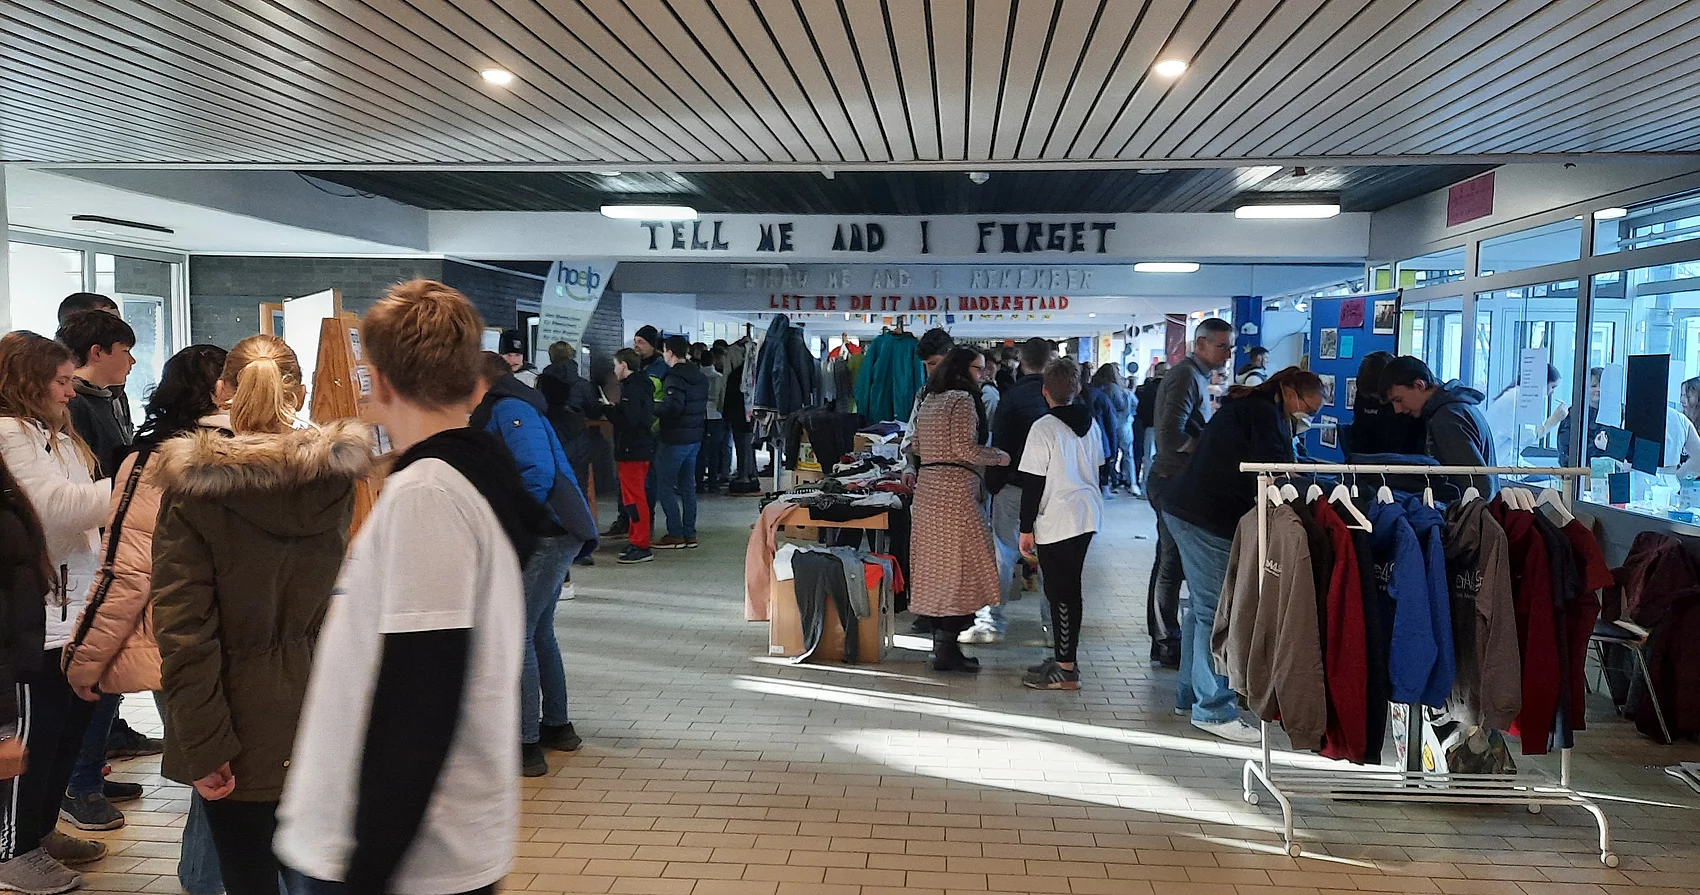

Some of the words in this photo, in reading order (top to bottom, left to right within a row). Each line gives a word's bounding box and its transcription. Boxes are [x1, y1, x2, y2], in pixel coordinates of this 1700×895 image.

[640, 220, 729, 250] TELL
[756, 222, 794, 252] ME
[831, 222, 885, 253] AND
[919, 220, 931, 254] I
[976, 221, 1116, 254] FORGET
[557, 260, 600, 294] hoelp
[827, 268, 850, 289] ME
[872, 268, 911, 289] AND
[933, 269, 941, 289] I
[970, 269, 1095, 290] REMEMBER
[769, 294, 804, 310] LET
[815, 295, 837, 310] ME
[880, 295, 902, 311] IT
[958, 295, 1069, 311] UNDERSTAND
